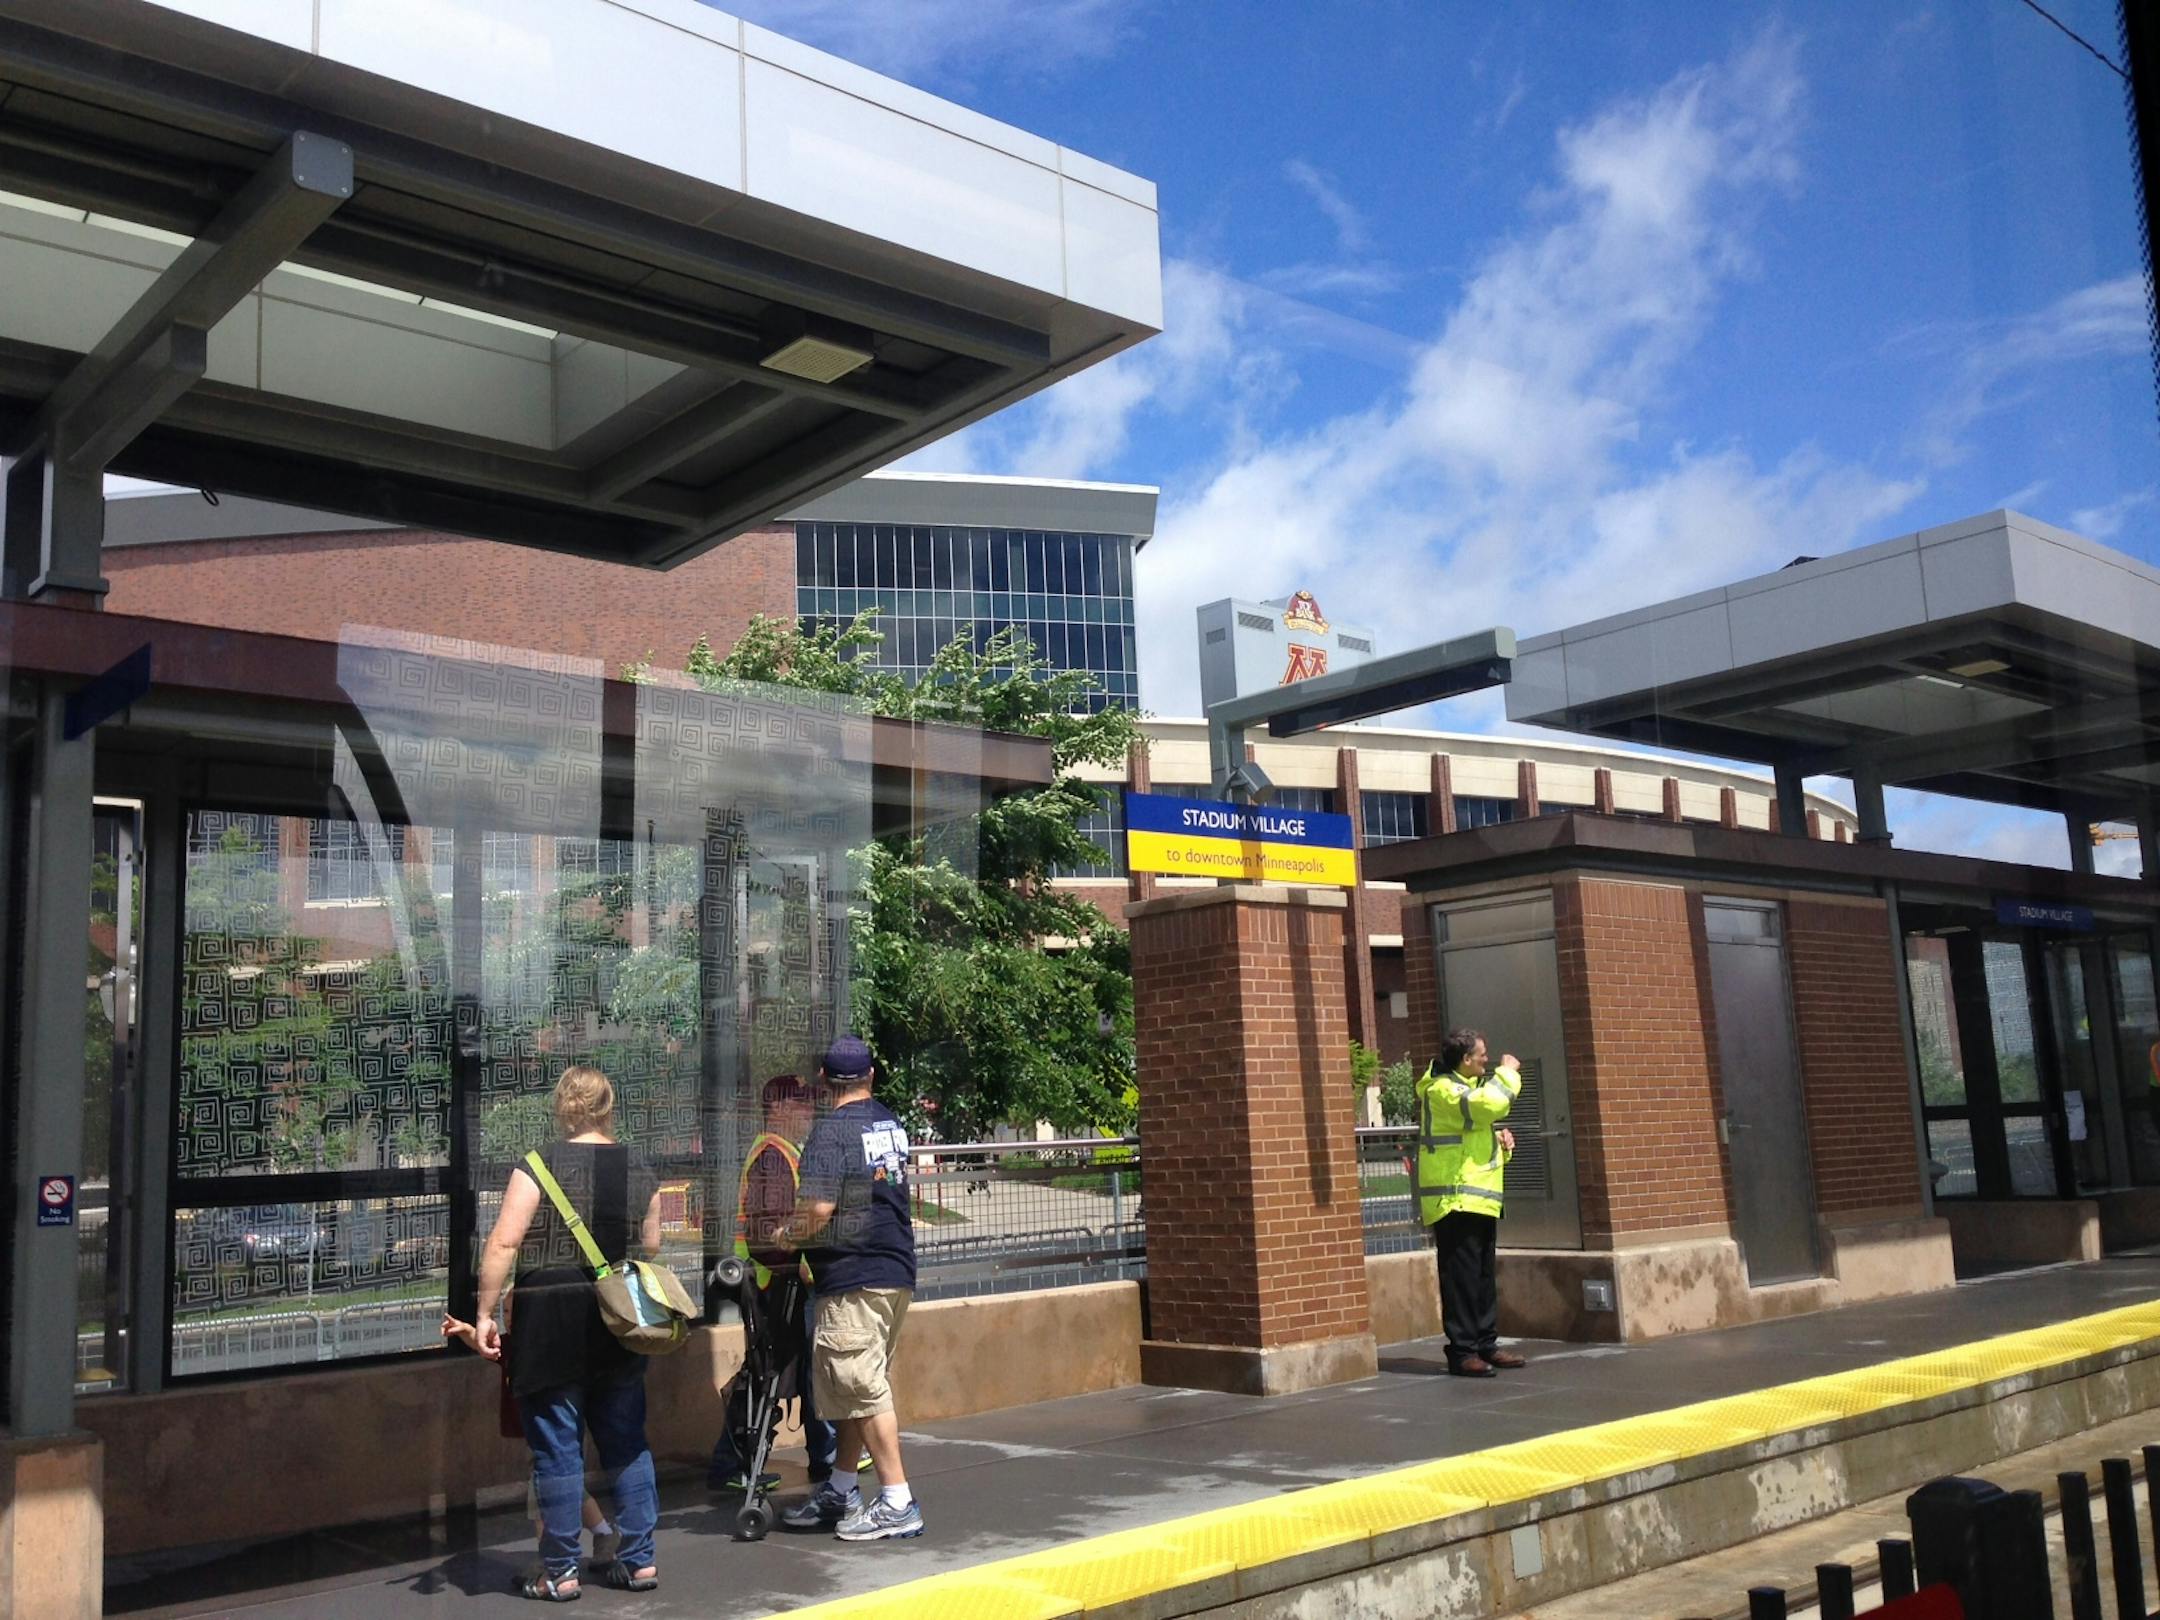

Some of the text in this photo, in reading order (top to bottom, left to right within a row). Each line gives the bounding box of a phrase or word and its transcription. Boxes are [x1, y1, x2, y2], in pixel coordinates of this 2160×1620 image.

[1280, 643, 1328, 686] M
[1183, 809, 1306, 836] STADIUM VILLAGE
[1167, 849, 1325, 875] to downtown Minneapolis
[2019, 906, 2073, 922] STADIUM VILLAGE
[40, 1215, 70, 1225] Smoking
[49, 1207, 62, 1215] No
